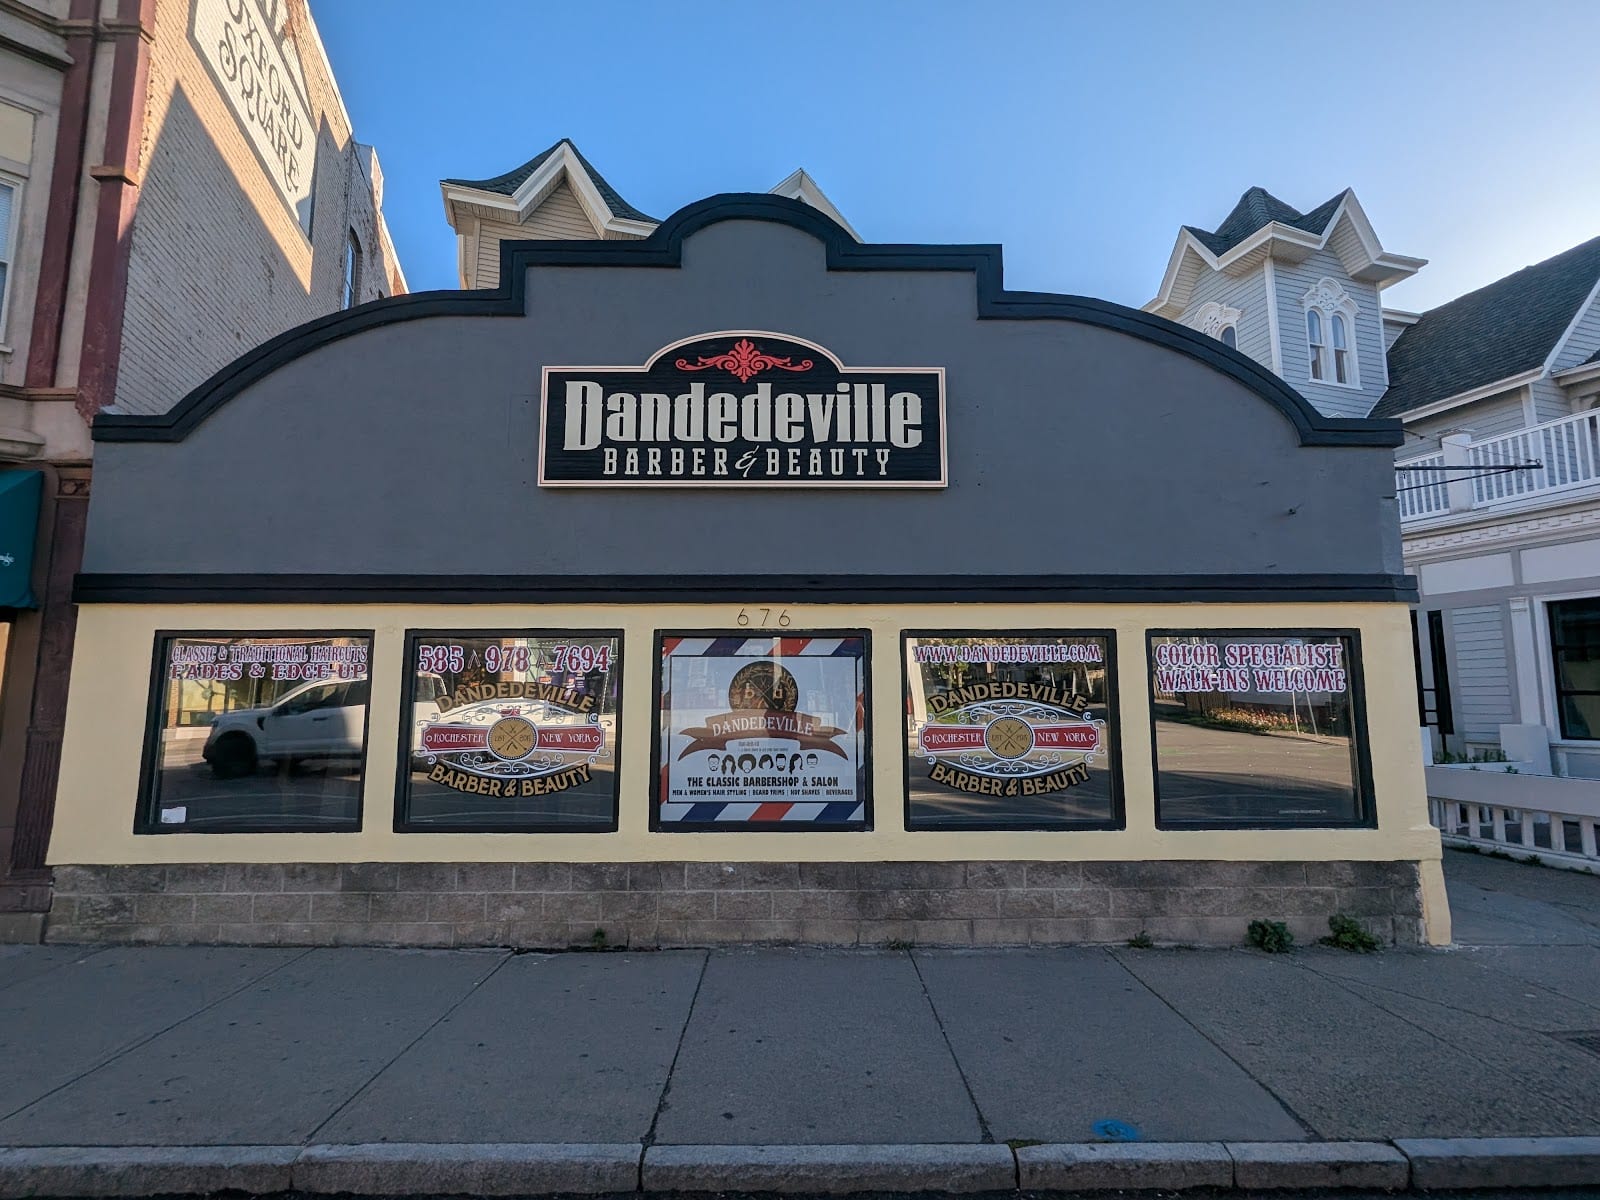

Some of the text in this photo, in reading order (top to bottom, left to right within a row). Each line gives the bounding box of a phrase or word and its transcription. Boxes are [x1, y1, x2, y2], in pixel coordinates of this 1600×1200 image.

[219, 21, 300, 194] SQUARE
[562, 380, 923, 451] Dandedeville
[603, 445, 891, 478] BARBER & BEAUTY
[737, 608, 791, 627] 676
[172, 645, 368, 663] CLASSIC & TRADITIONAL HAIRCUTS
[418, 645, 610, 673] 585 978 7694
[912, 644, 1103, 663] WWW.DANDEDEVILLE.COM
[1155, 643, 1343, 668] COLOR SPECIALIST
[169, 662, 368, 681] FADES & EDGE-UP
[1157, 667, 1347, 693] WALK-INS WELCOME
[435, 681, 596, 713] DANDEDEVILLE
[928, 682, 1089, 713] DANDEDEVILLE
[433, 732, 485, 744] ROCHESTER
[541, 732, 563, 744] NEW
[568, 732, 592, 744] YORK
[712, 716, 814, 737] DANDEDEVILLE
[931, 732, 983, 744] ROCHESTER
[1037, 732, 1059, 743] NEW
[1064, 732, 1088, 743] YORK
[428, 763, 593, 798] BARBER & BEAUTY
[687, 776, 839, 787] THE CLASSIC BARBERSHOP & SALON
[929, 762, 1091, 797] BARBER & BEAUTY
